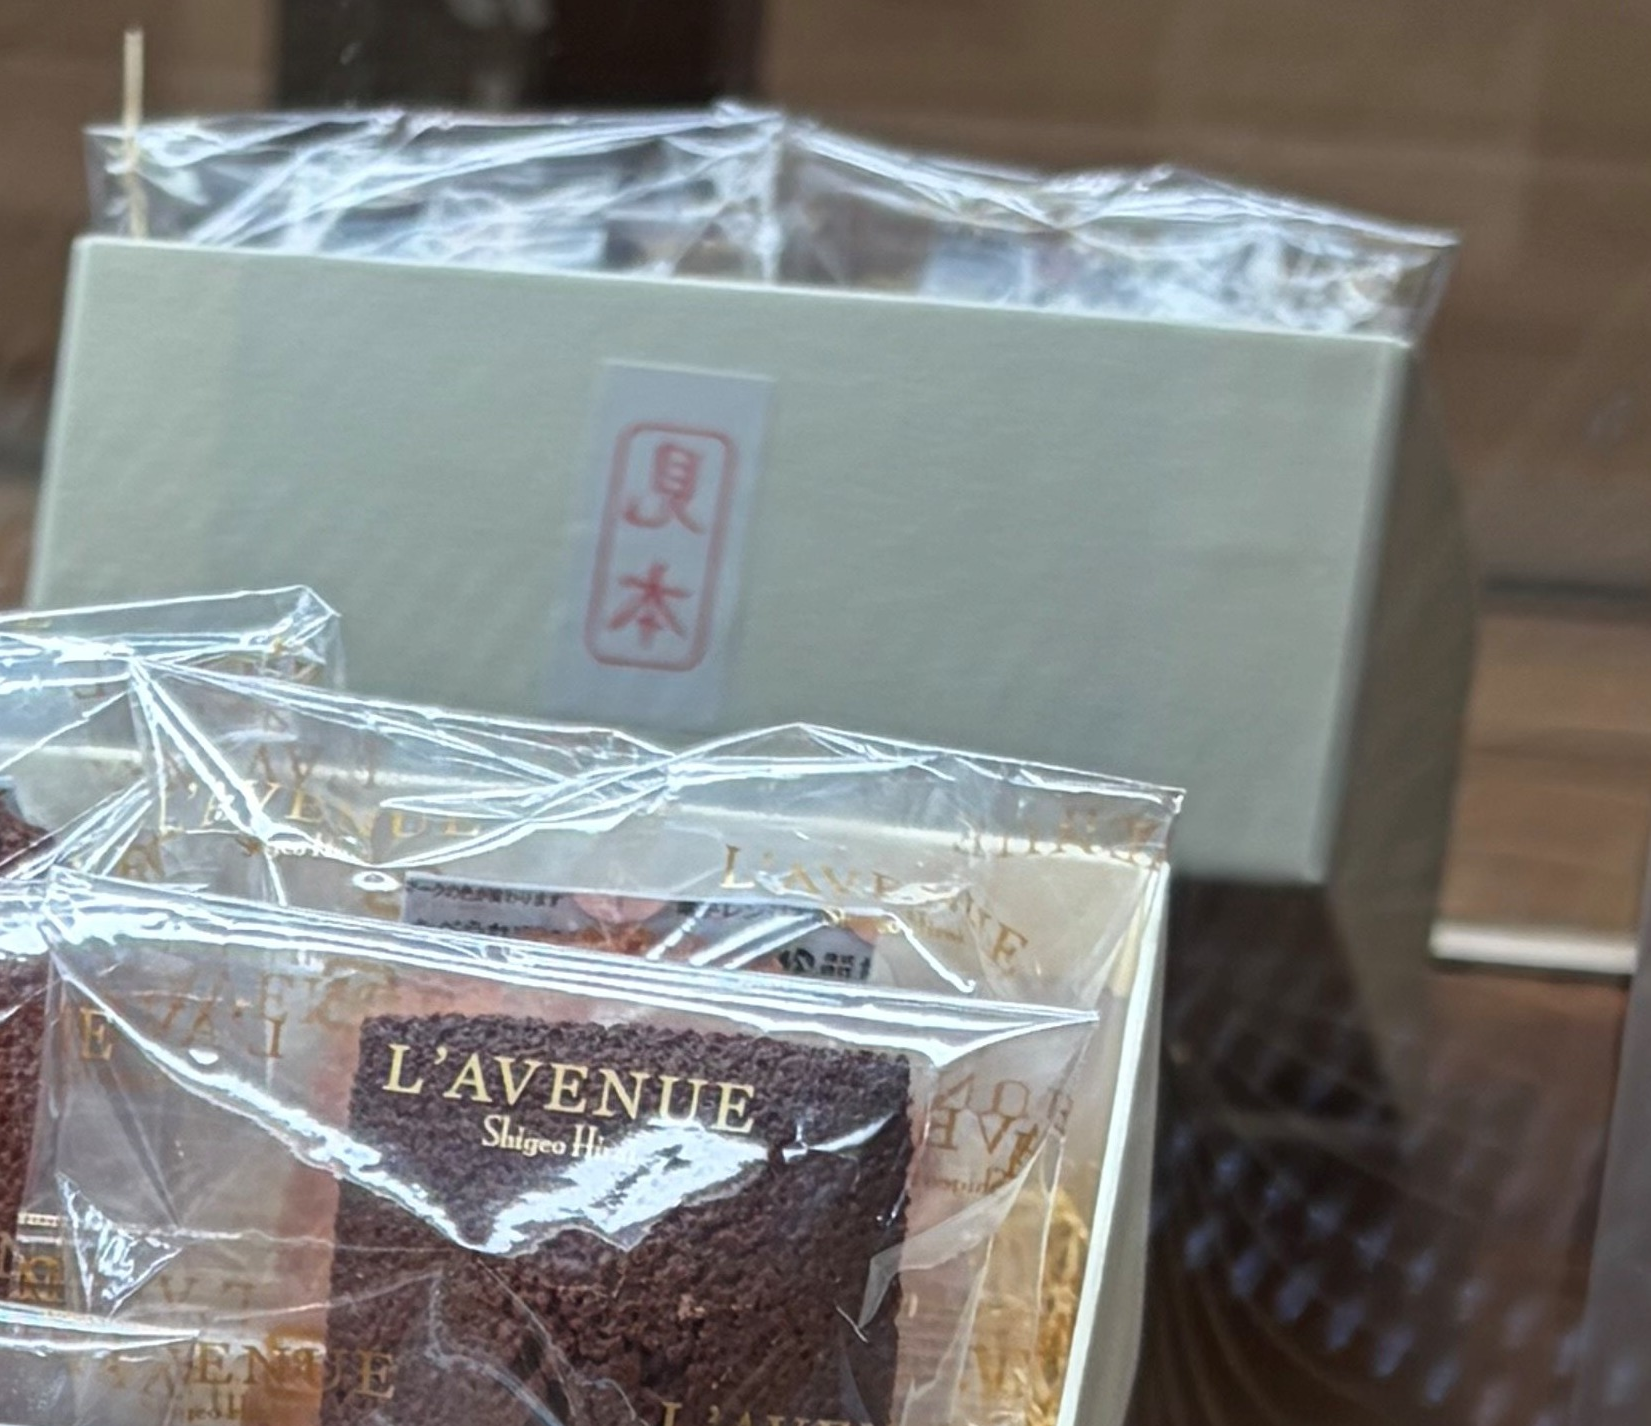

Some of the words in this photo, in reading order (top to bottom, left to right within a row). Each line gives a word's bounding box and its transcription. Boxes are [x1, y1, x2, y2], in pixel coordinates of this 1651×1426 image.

[607, 441, 706, 648] 見本
[382, 1043, 755, 1133] L'AVENUE
[481, 1114, 567, 1158] Shigeo
